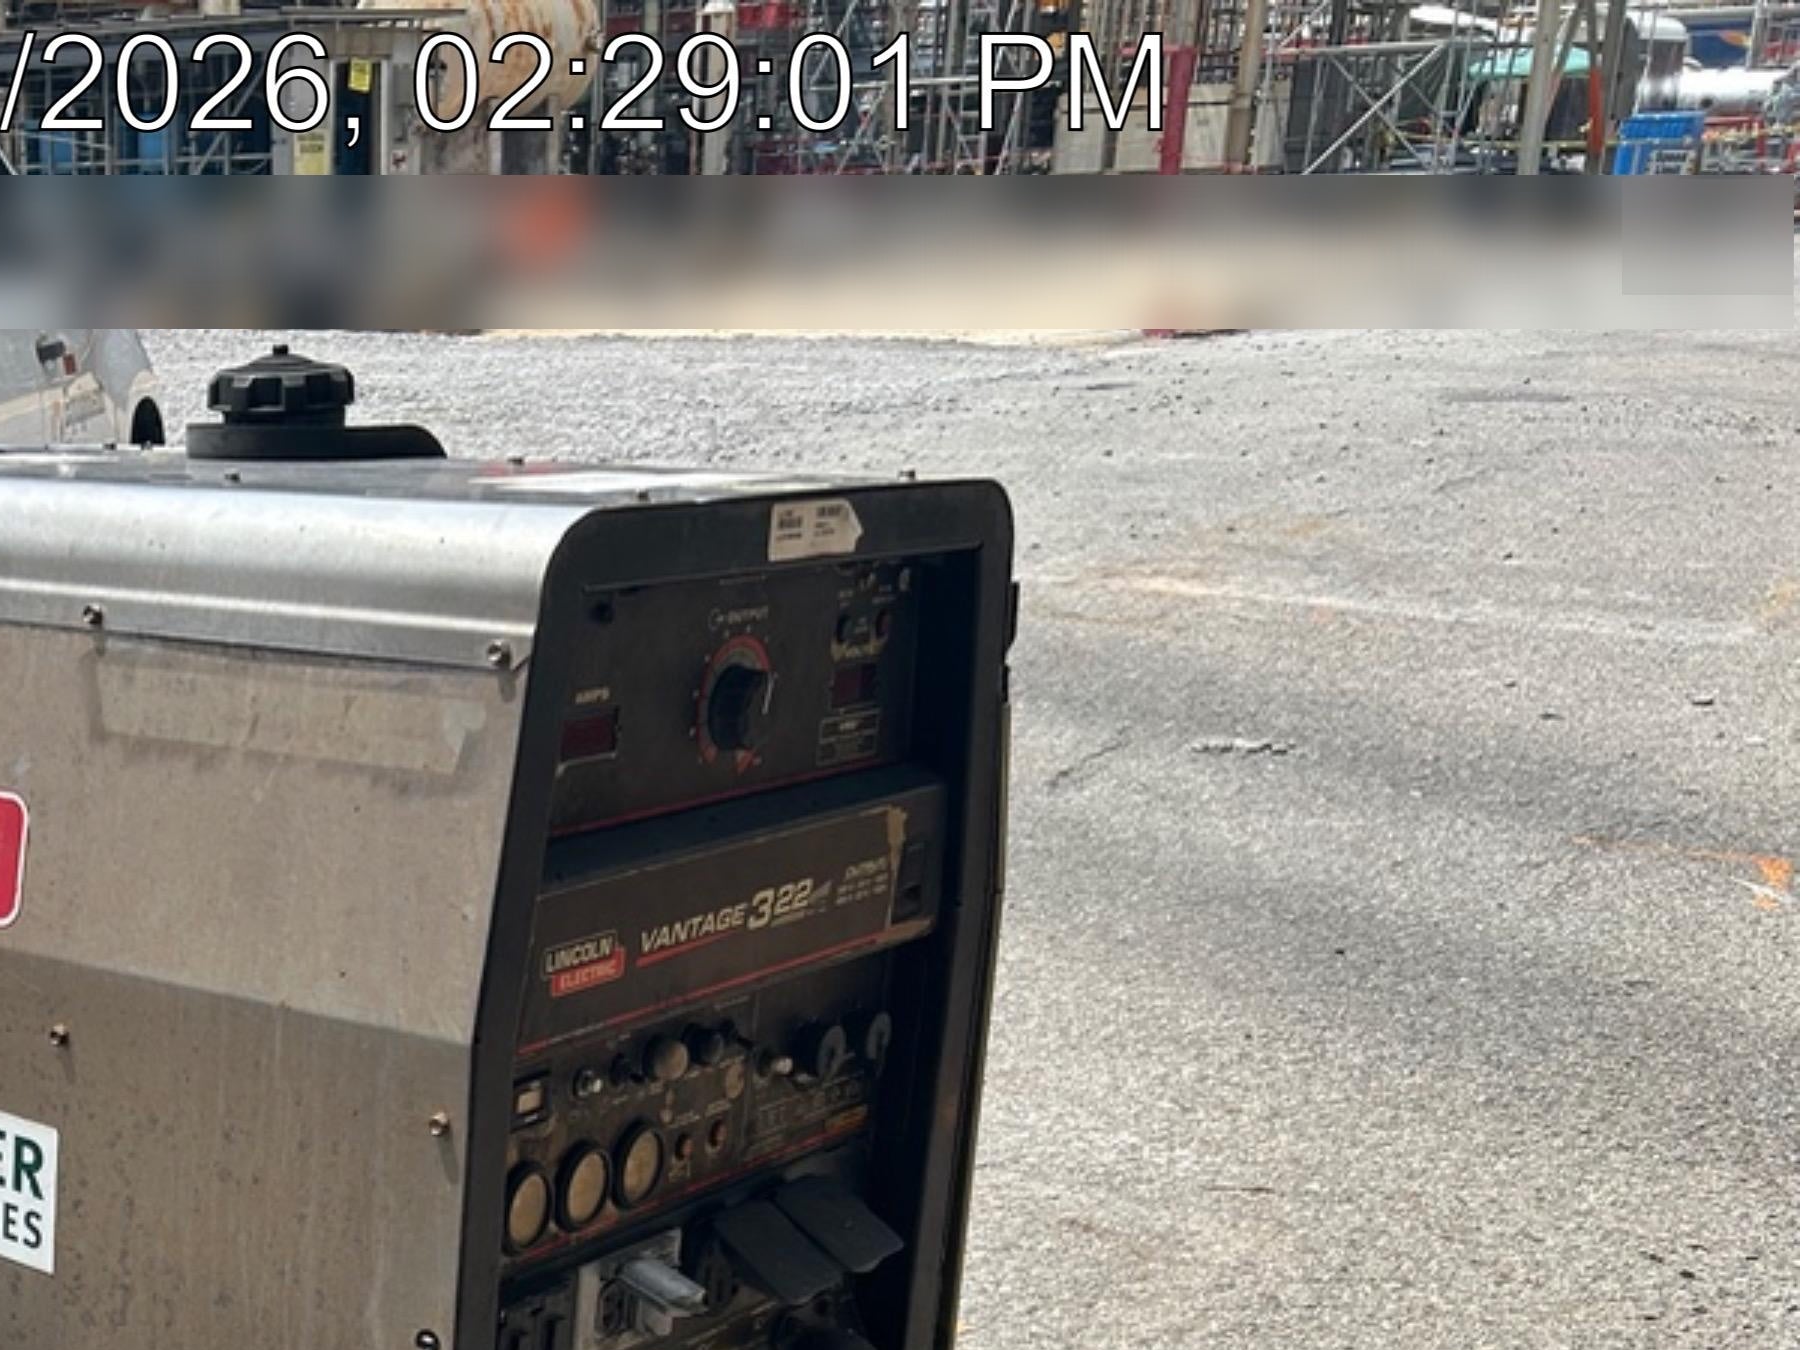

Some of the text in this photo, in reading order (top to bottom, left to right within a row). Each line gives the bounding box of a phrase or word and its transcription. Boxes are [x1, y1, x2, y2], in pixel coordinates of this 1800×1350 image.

[640, 901, 748, 952] VANTAGE
[747, 877, 814, 932] 322
[545, 934, 615, 973] LINCOLN
[559, 960, 617, 990] ELECTRIC
